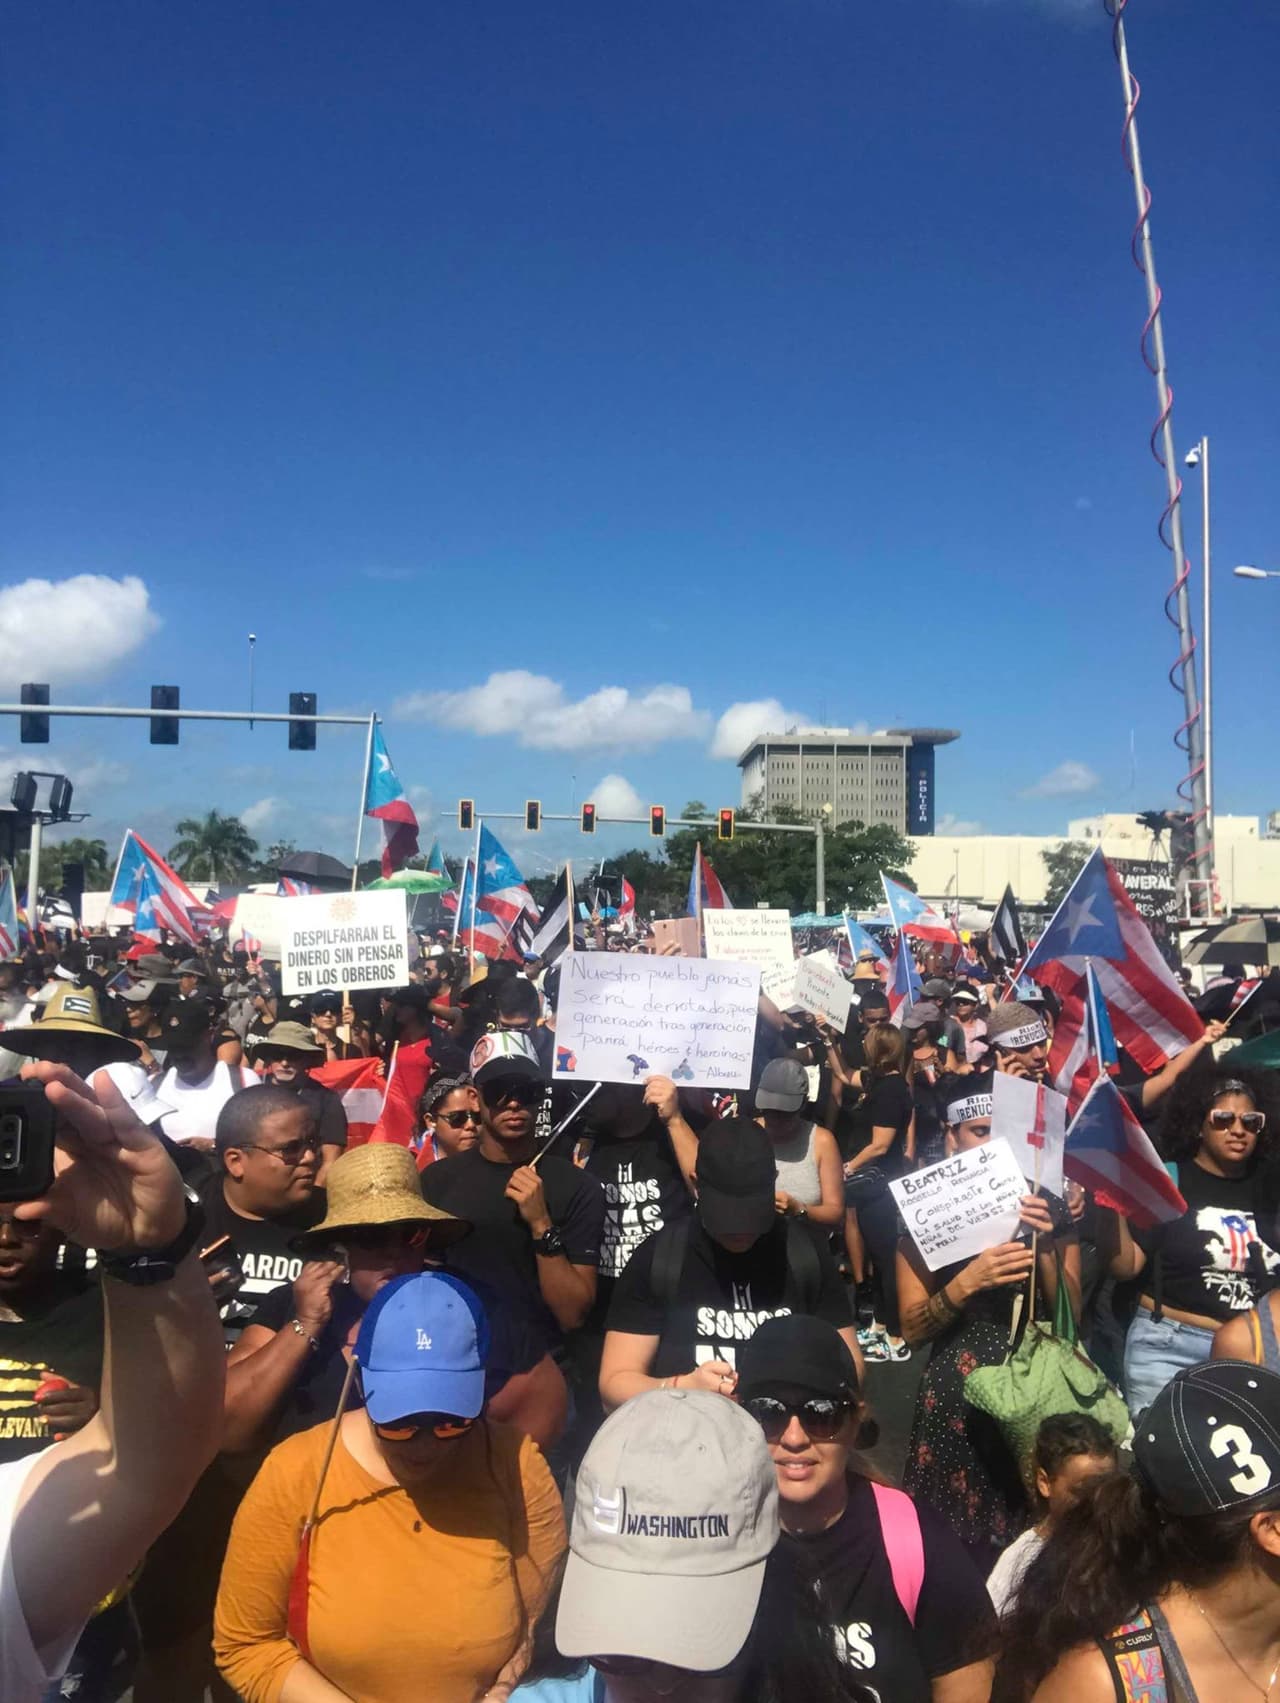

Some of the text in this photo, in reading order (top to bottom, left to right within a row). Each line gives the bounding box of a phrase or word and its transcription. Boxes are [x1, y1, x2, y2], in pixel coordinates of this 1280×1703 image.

[293, 924, 397, 948] DESPILFARRAN EL
[287, 944, 403, 968] DINERO SIN PENSAR
[297, 964, 396, 987] EN LOS OBREROS
[648, 959, 699, 991] pueblo
[659, 1018, 686, 1031] tras
[900, 1158, 968, 1194] BEATRIZ
[601, 1178, 661, 1203] OMOS
[237, 1252, 304, 1282] ARDO
[416, 1328, 432, 1350] LA
[1209, 1424, 1272, 1496] 3
[627, 1514, 730, 1539] WASHINGTON
[1126, 1632, 1153, 1646] CURLY
